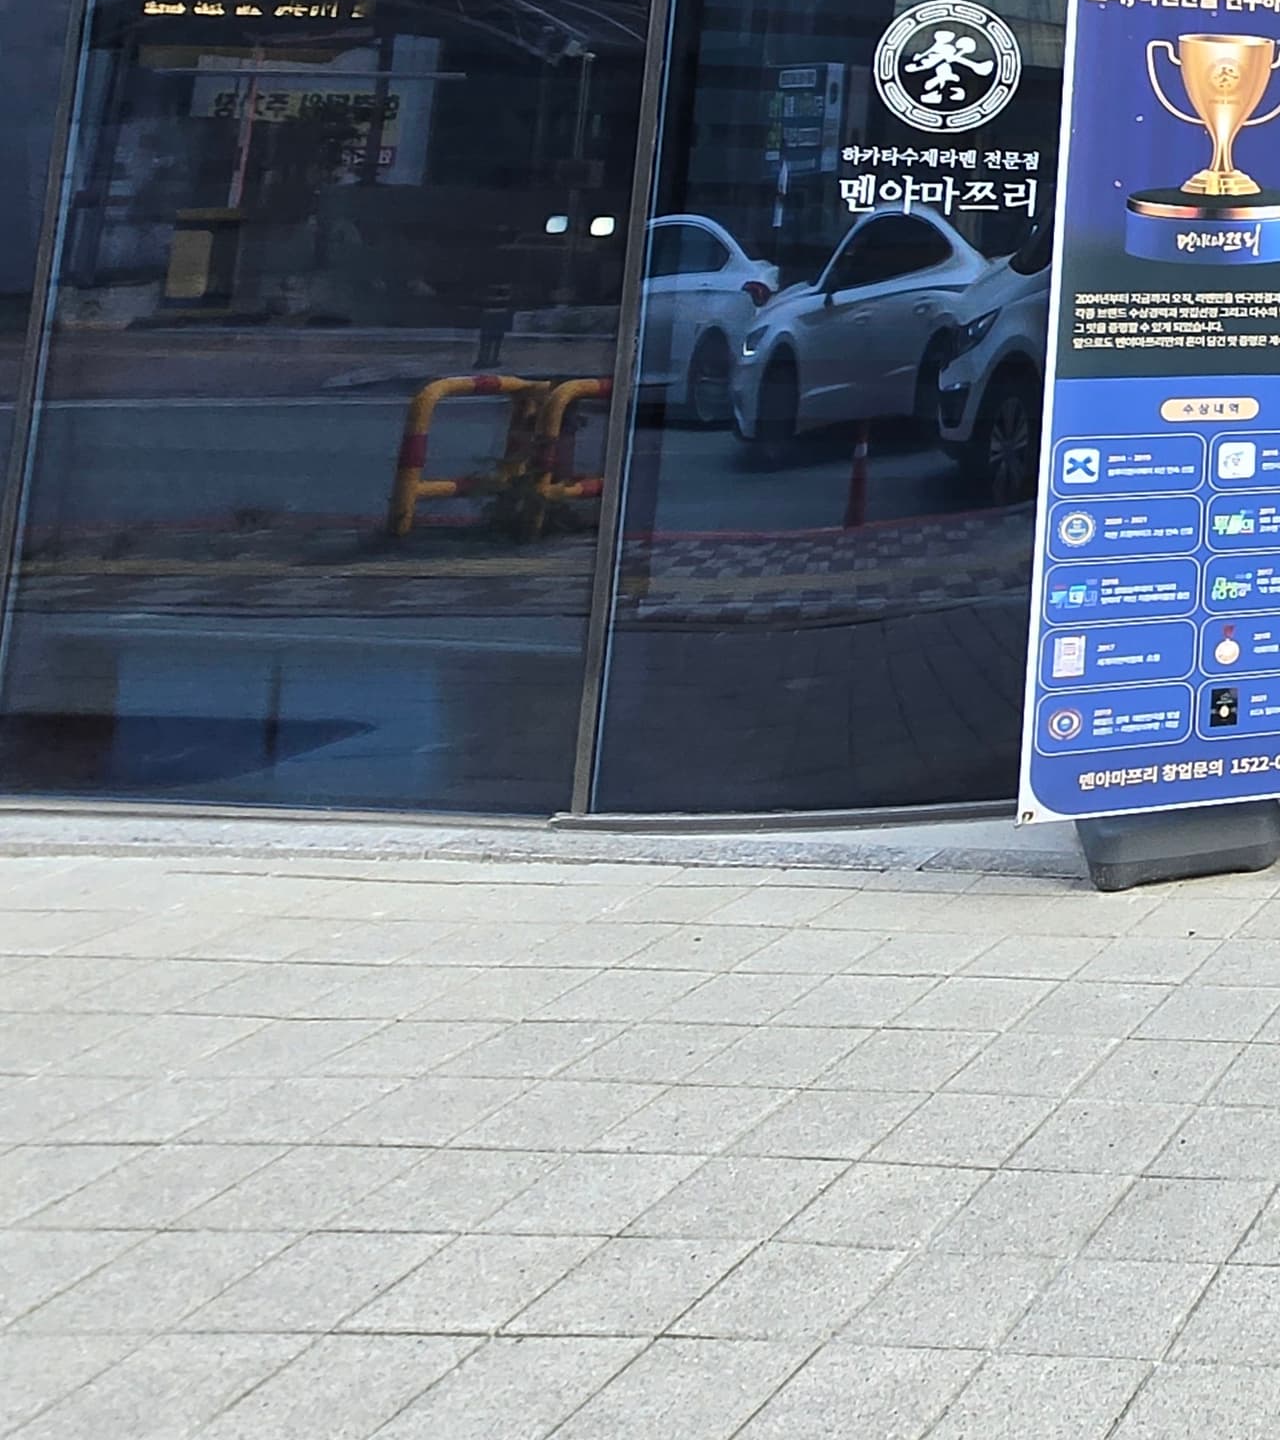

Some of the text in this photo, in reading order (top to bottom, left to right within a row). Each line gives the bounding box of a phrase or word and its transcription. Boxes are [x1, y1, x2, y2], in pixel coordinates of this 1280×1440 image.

[841, 145, 1040, 171] 하카타수제라멘 전문점
[839, 174, 1037, 217] 멘야마쯔리
[1079, 765, 1157, 790] 멘야마쯔리
[1162, 759, 1223, 781] 창업문의
